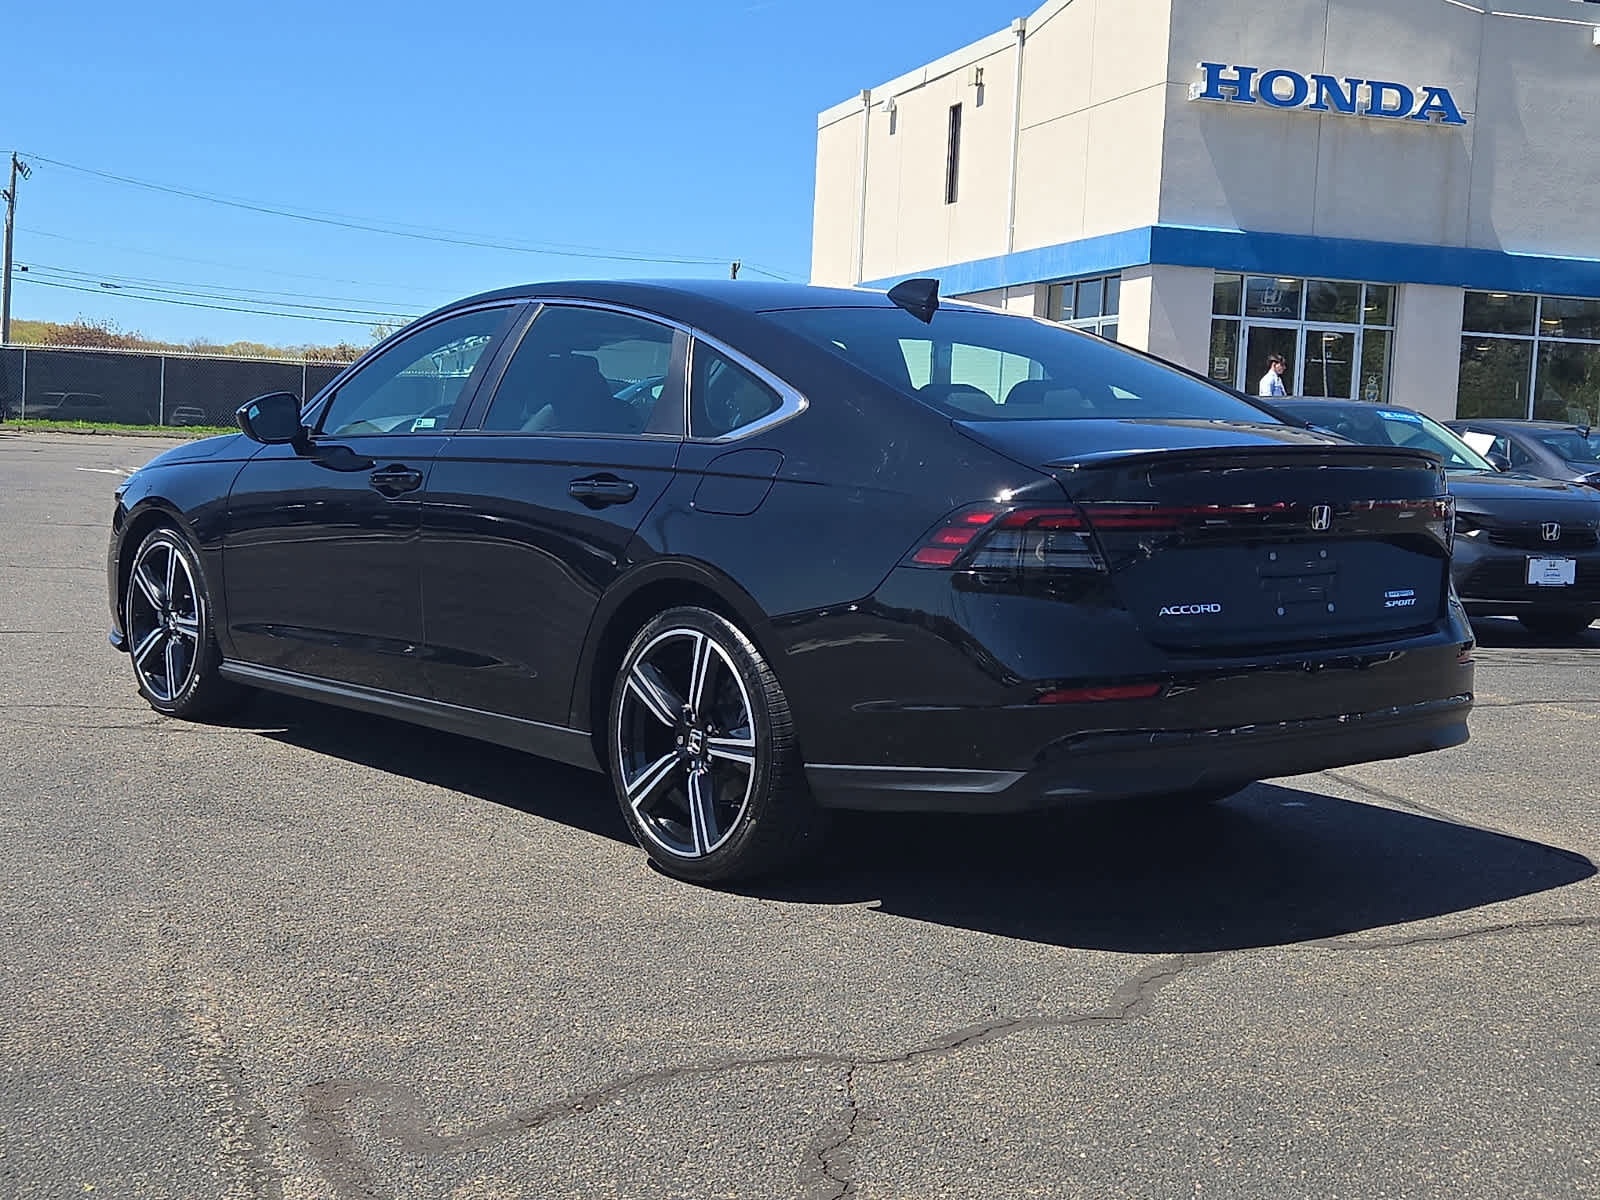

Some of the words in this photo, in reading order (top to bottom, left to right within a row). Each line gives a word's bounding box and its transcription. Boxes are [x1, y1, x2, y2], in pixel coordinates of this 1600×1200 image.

[1198, 62, 1467, 125] HONDA
[1158, 603, 1221, 617] ACCORD
[1384, 598, 1416, 608] SPORT
